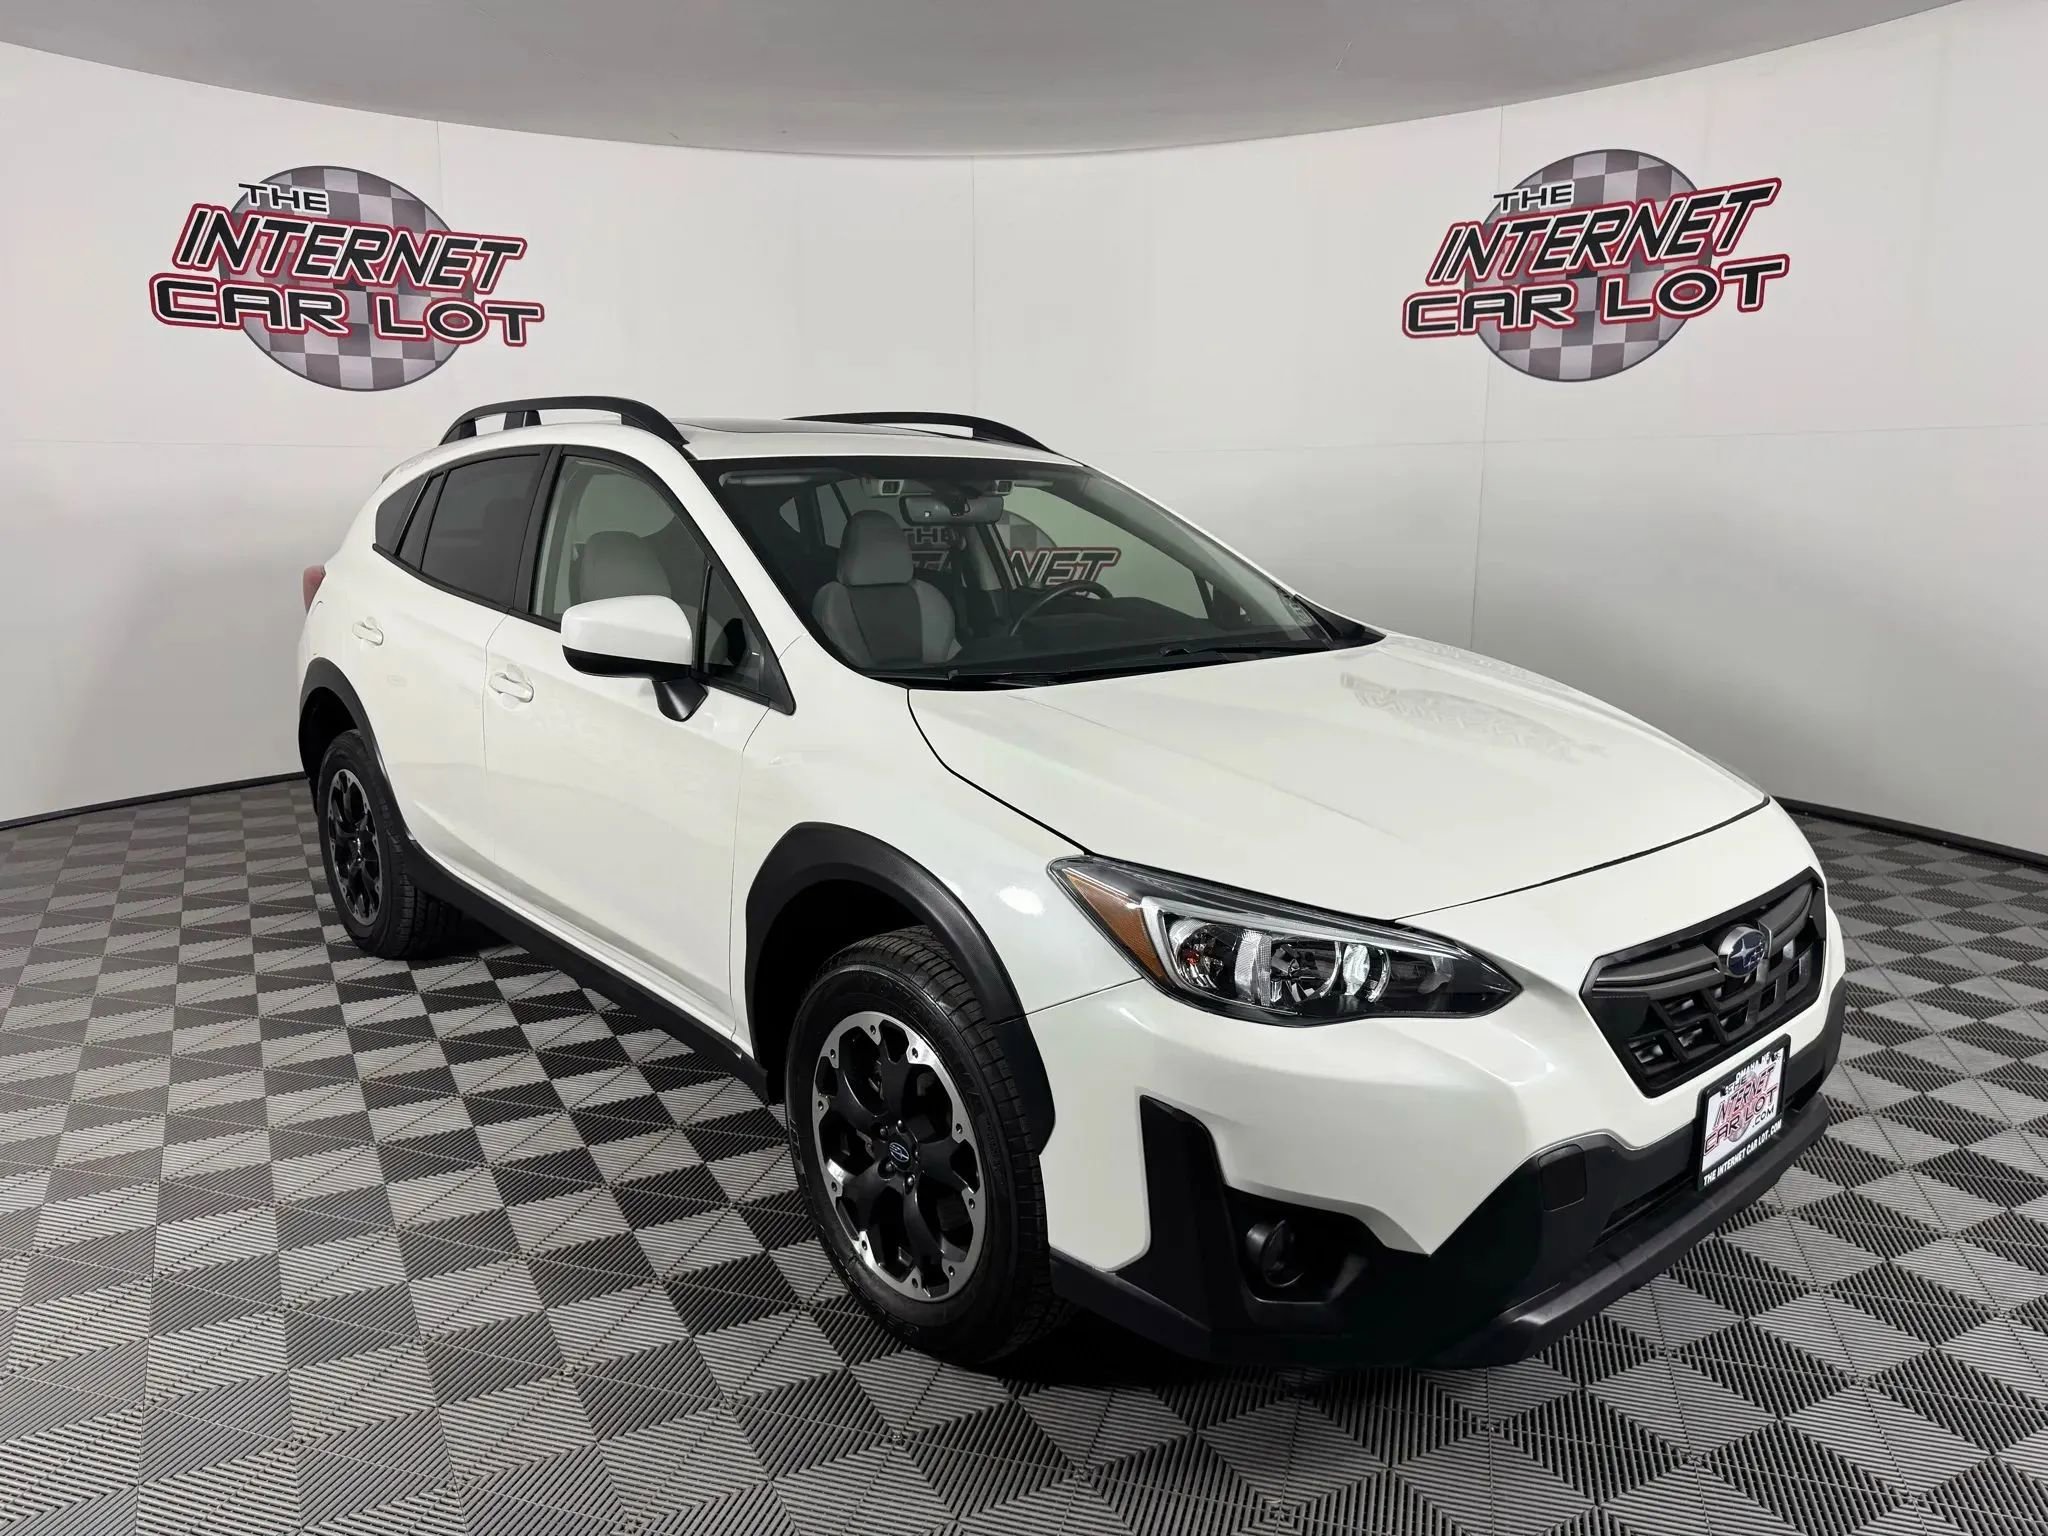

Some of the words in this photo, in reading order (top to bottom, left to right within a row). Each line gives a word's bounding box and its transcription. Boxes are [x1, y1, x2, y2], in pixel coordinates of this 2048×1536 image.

[238, 183, 330, 215] THE
[1426, 178, 1781, 285] INTERNET
[1493, 181, 1575, 213] THE
[173, 204, 526, 293] INTERNET
[150, 274, 349, 337] CAR
[375, 296, 544, 346] LOT
[1403, 281, 1577, 338] CAR
[1600, 255, 1789, 324] LOT
[1704, 1114, 1742, 1156] CAR
[1744, 1083, 1778, 1122] LOT
[1714, 1062, 1776, 1128] INTERNET
[1752, 1104, 1775, 1128] .COM
[1703, 1169, 1716, 1186] THE
[1716, 1147, 1746, 1177] INTERNET
[1746, 1138, 1758, 1156] CAR
